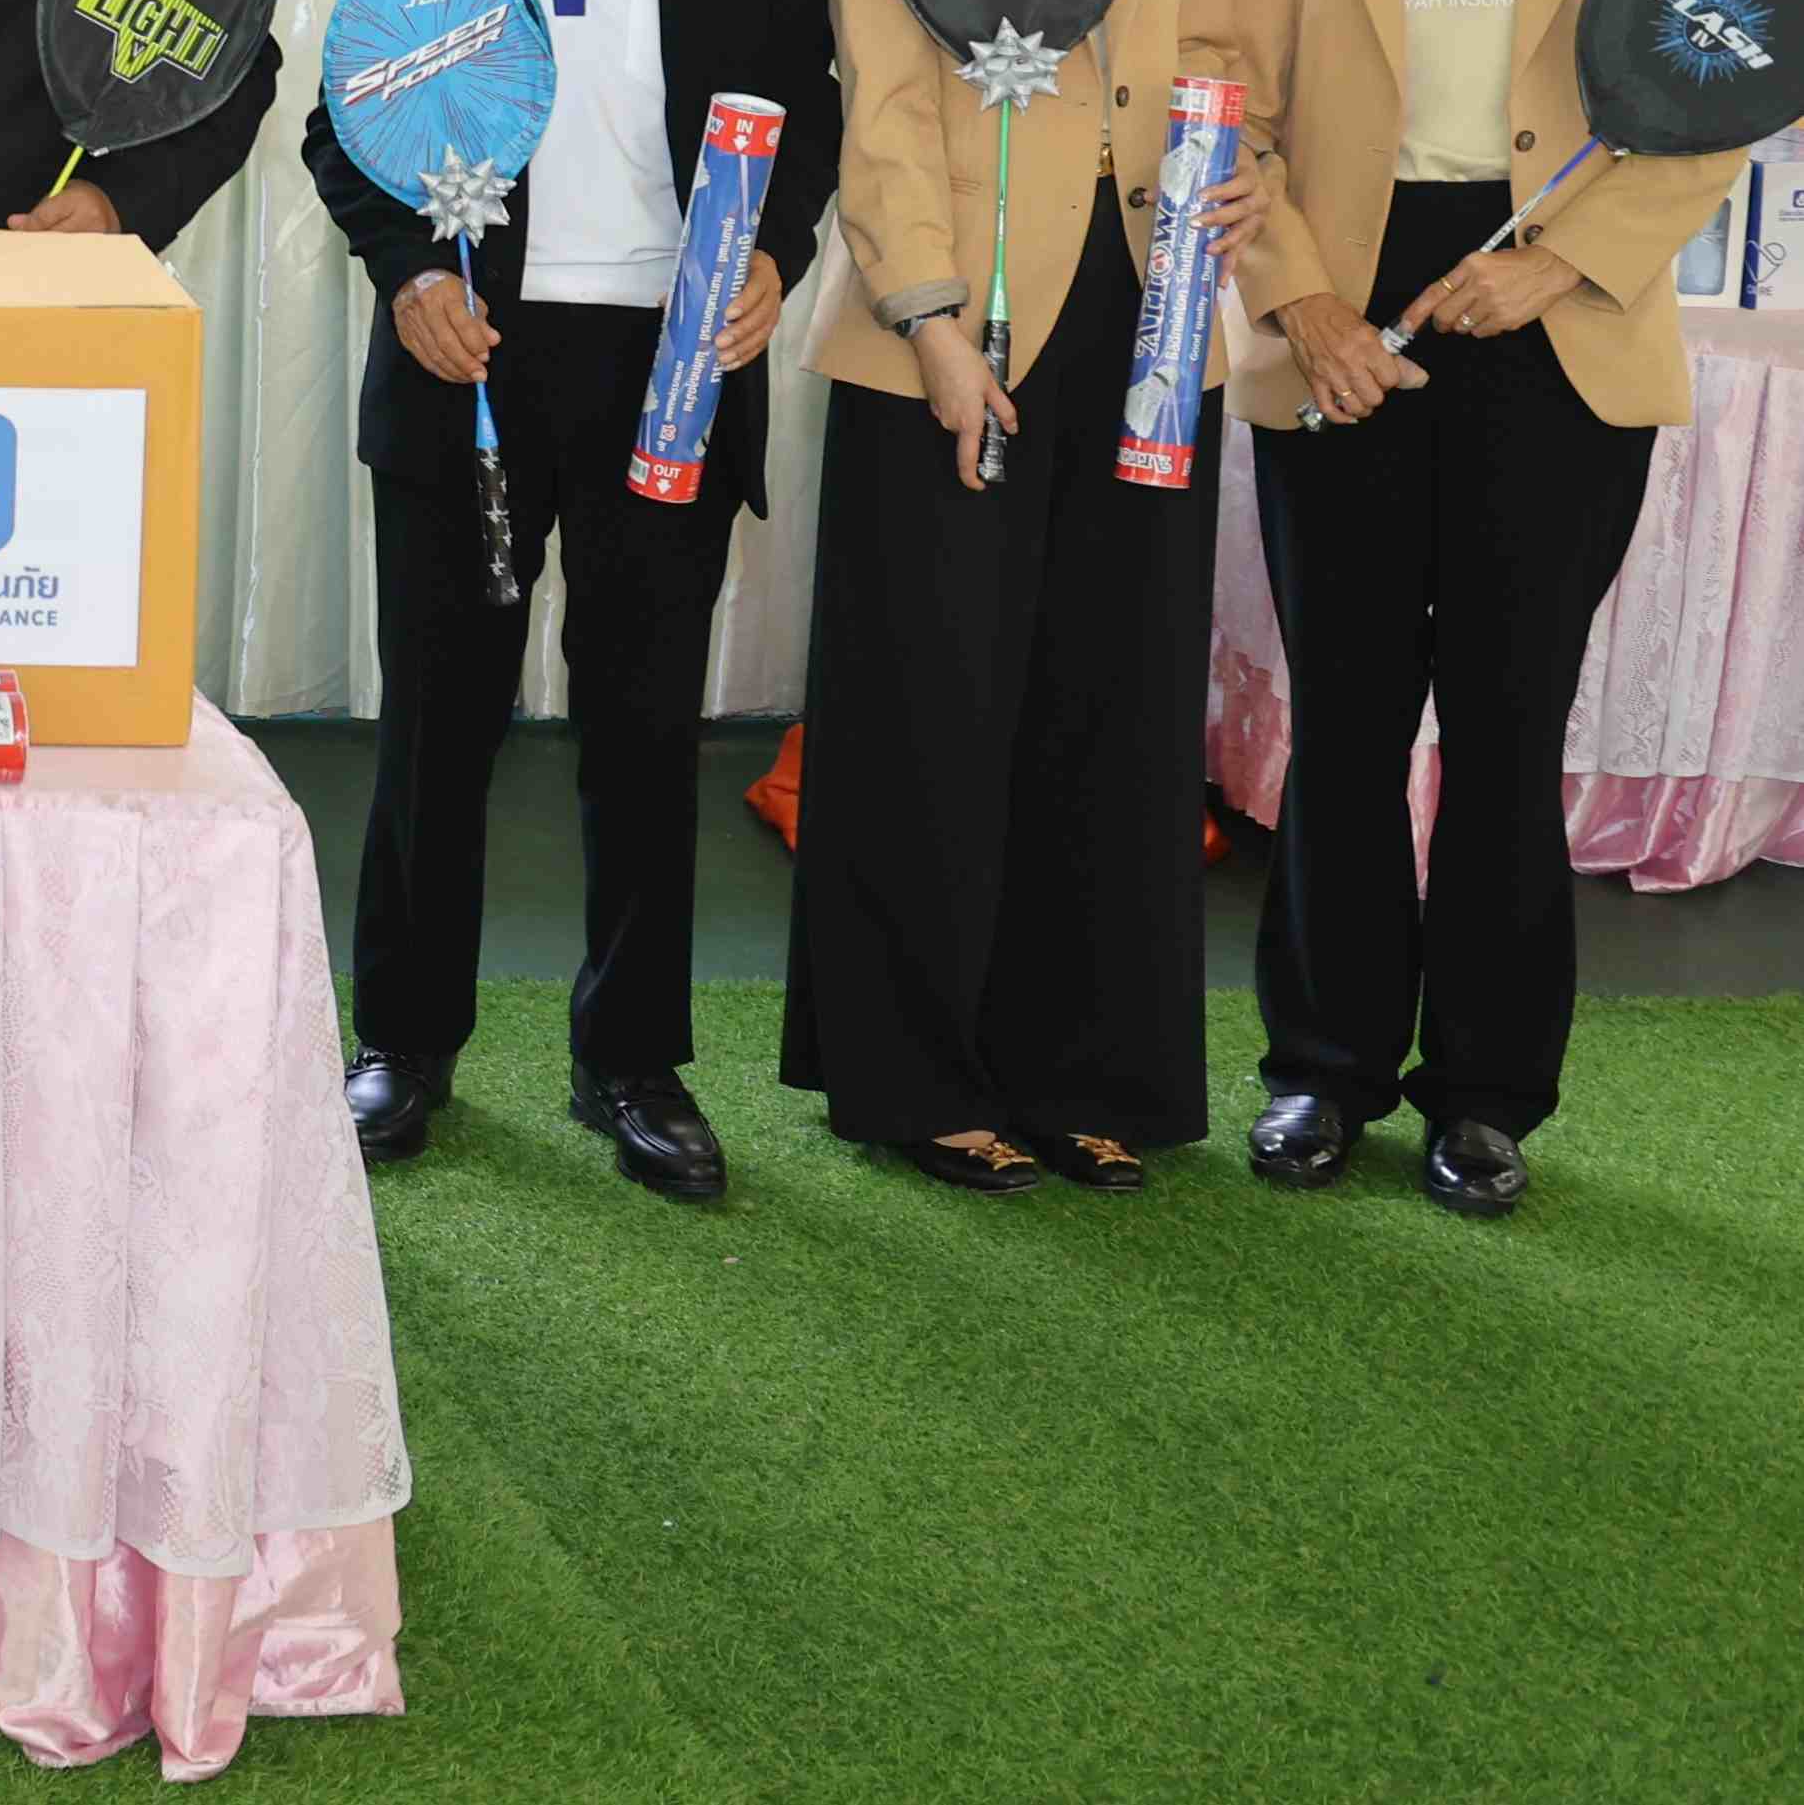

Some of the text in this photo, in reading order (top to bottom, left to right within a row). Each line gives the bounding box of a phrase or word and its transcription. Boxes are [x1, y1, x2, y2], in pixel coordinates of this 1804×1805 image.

[342, 3, 511, 106] SPEED
[381, 27, 504, 101] POWER
[735, 117, 754, 135] IN
[1134, 199, 1180, 359] Arrow
[652, 463, 682, 480] OUT
